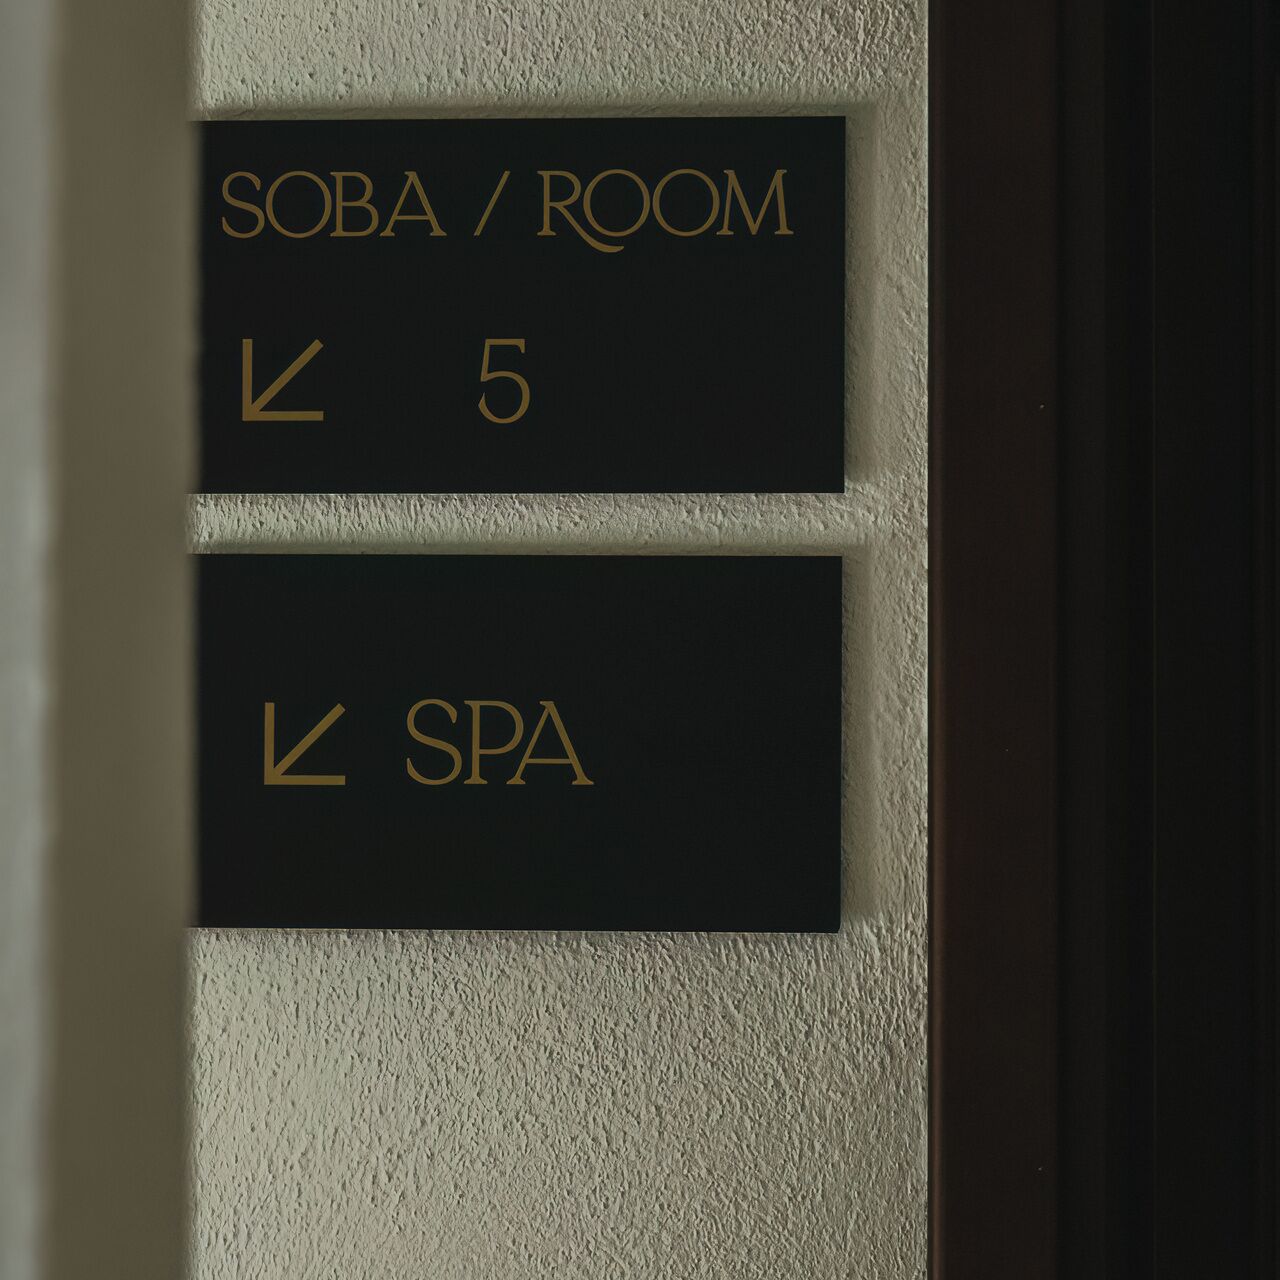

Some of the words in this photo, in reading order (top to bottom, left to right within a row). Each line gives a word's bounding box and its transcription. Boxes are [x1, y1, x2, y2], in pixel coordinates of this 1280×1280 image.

[221, 170, 448, 239] SOBA
[474, 170, 512, 238] /
[536, 168, 795, 254] ROOM
[477, 337, 532, 425] 5
[405, 698, 595, 787] SPA
